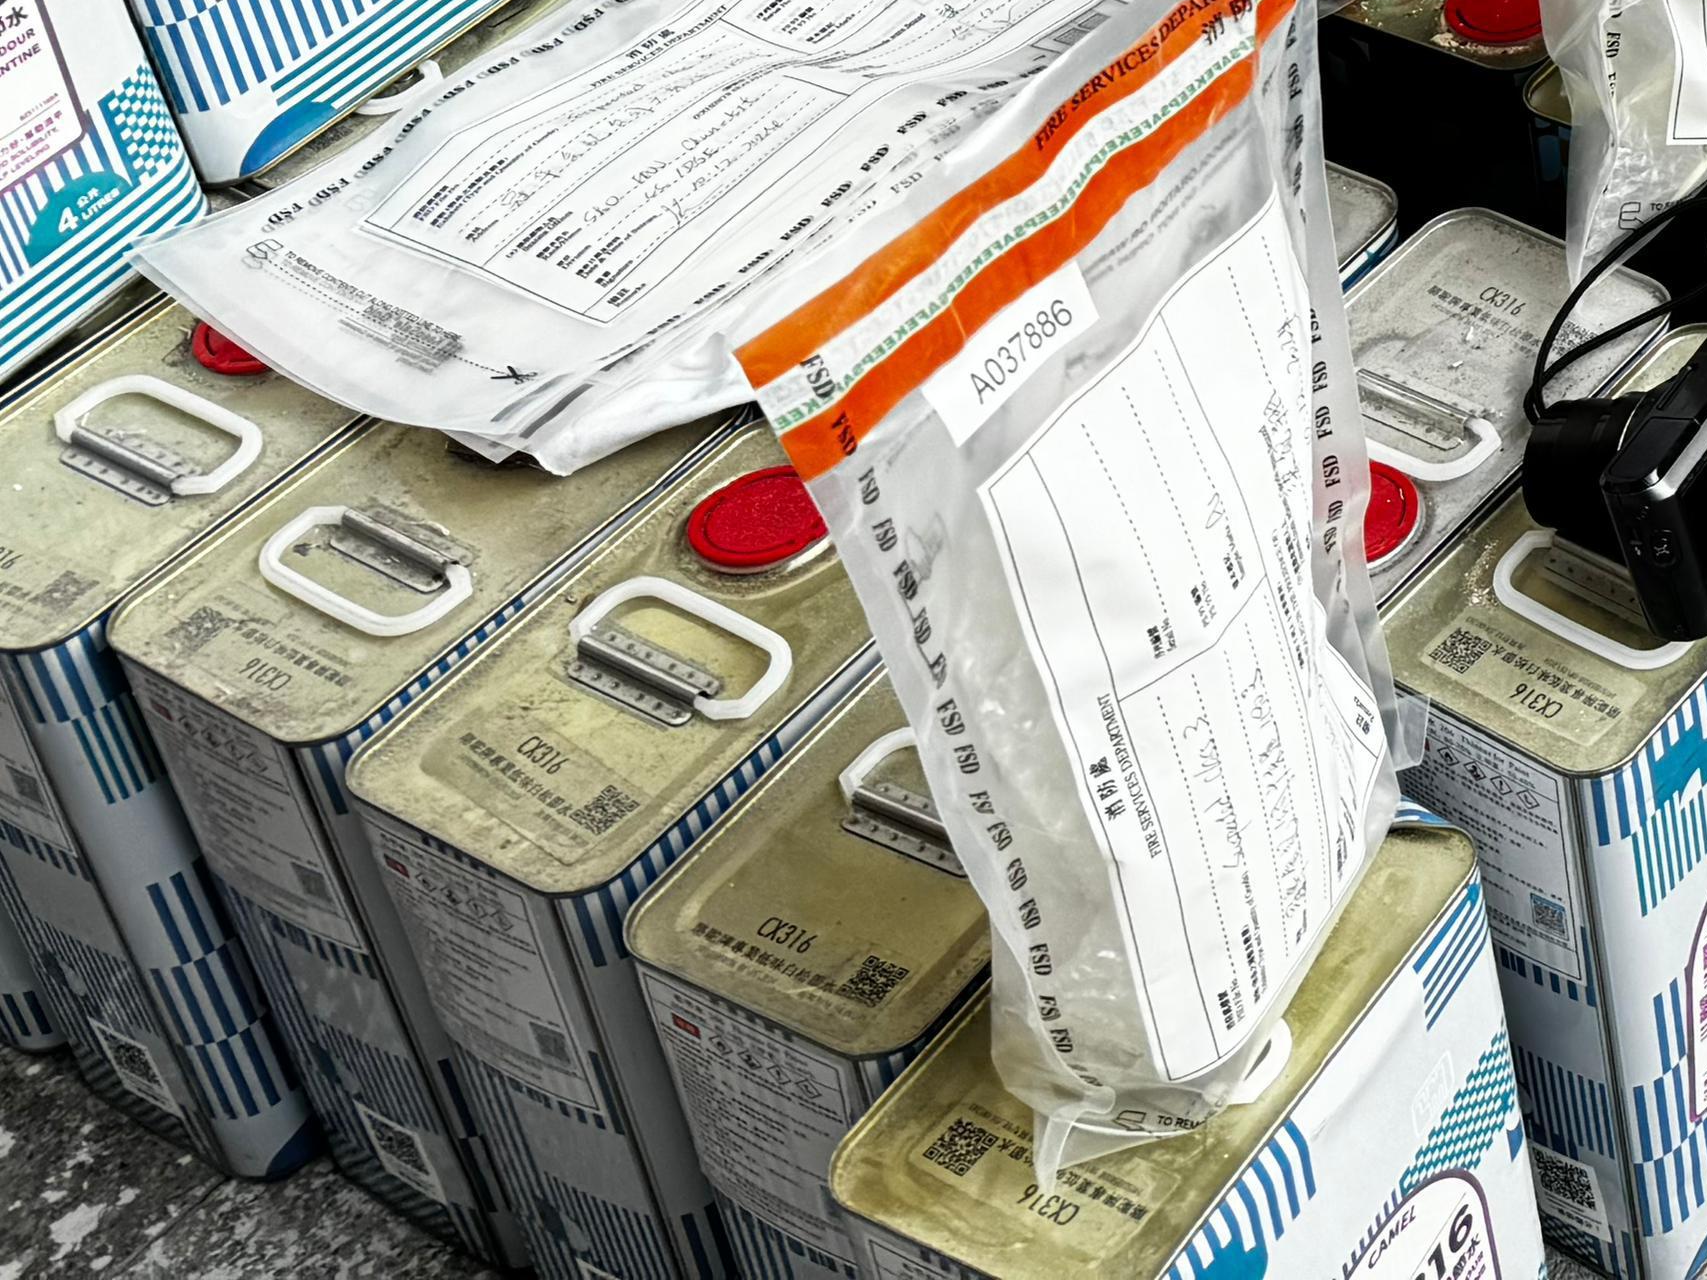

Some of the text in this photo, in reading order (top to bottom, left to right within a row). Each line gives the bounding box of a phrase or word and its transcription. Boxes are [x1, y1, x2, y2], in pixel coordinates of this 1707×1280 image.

[1034, 104, 1067, 151] FIRE
[1071, 36, 1161, 109] SERVICES
[861, 144, 890, 172] FSD
[317, 177, 351, 201] FSD
[821, 180, 854, 208] FSD
[57, 206, 80, 234] 4
[970, 298, 1073, 405] A037886
[801, 355, 837, 400] FSD
[1316, 403, 1335, 443] FSD
[858, 465, 881, 506] FSD
[1321, 453, 1343, 490] FSD
[873, 517, 899, 553] FSD
[239, 657, 293, 691] CX316
[936, 697, 967, 737] FSD
[1509, 682, 1564, 719] CX316
[1096, 692, 1134, 772] DEPARTMENT
[516, 734, 571, 775] CX316
[953, 743, 981, 776] FSD
[986, 820, 1014, 852] FSD
[1144, 835, 1163, 859] FIRE
[1005, 857, 1029, 892] FSD
[1019, 897, 1042, 931] FSD
[757, 916, 819, 954] CX316
[1028, 942, 1053, 977] FSD
[1157, 1115, 1174, 1128] TO
[1016, 1183, 1081, 1227] CX316
[1367, 1204, 1417, 1269] CAMEL
